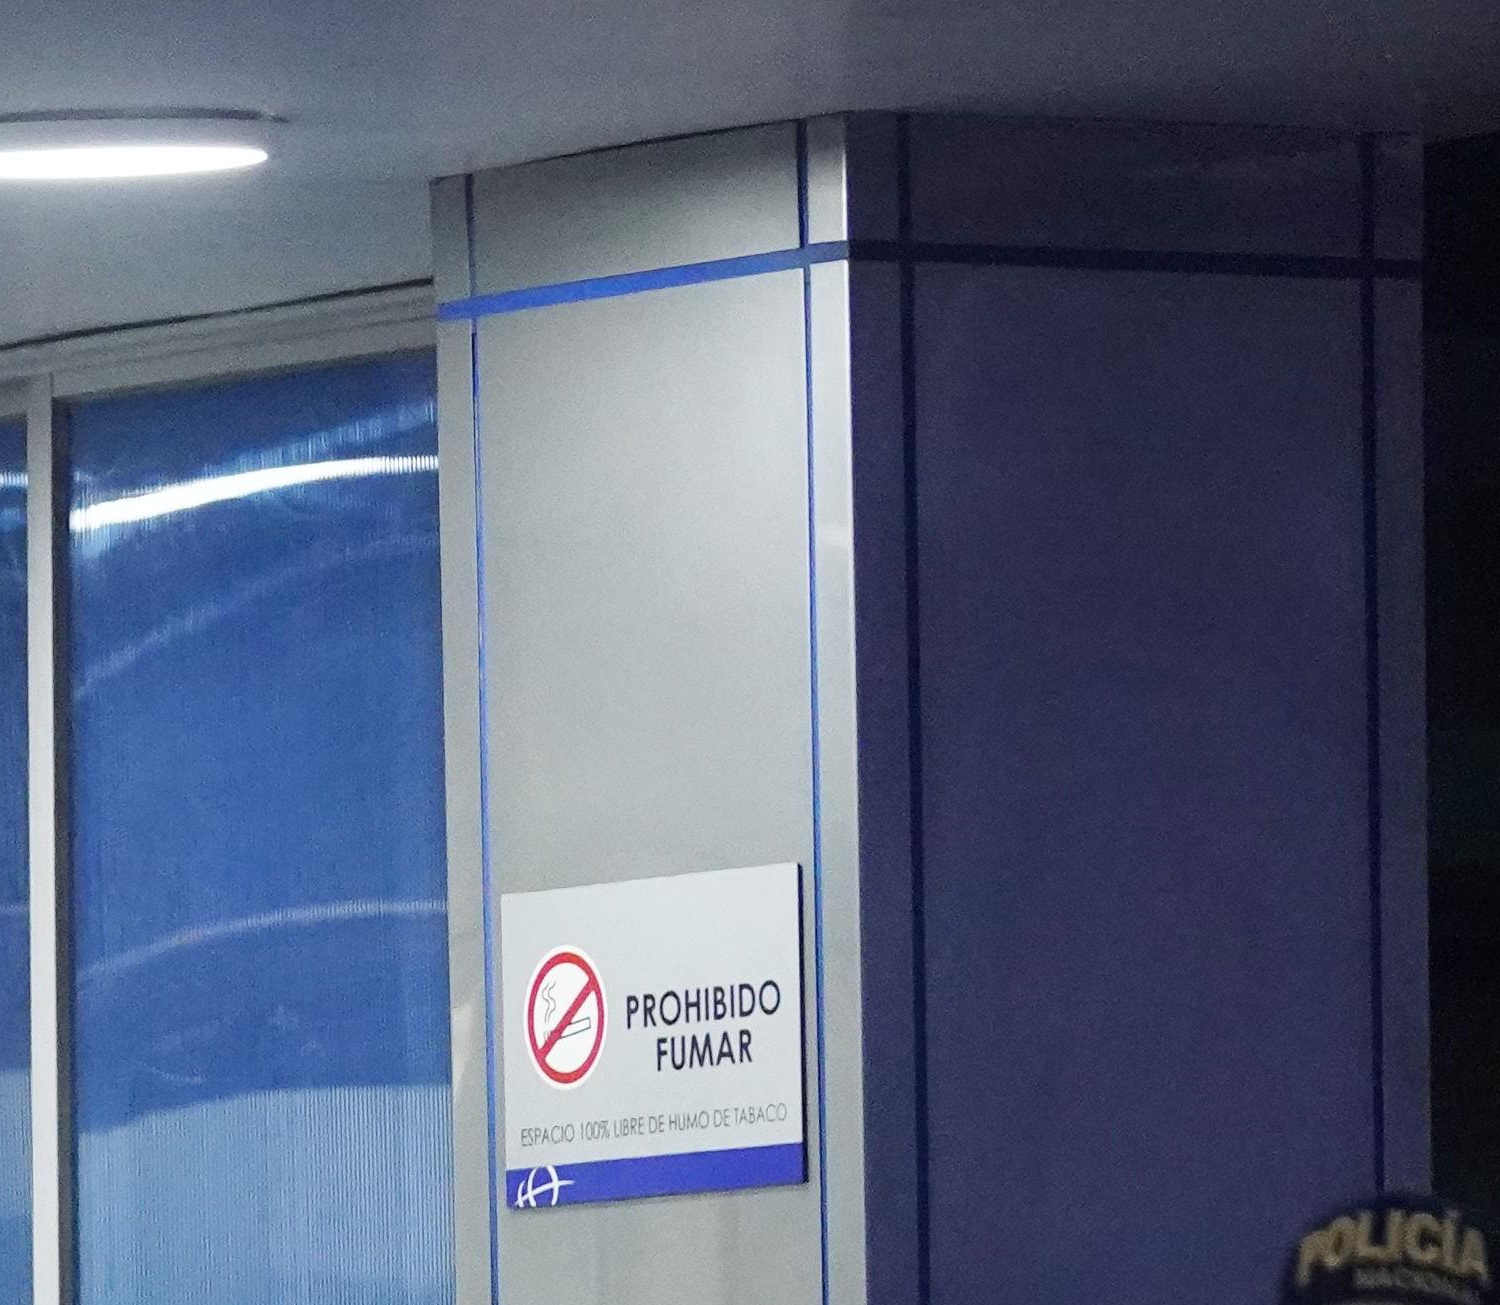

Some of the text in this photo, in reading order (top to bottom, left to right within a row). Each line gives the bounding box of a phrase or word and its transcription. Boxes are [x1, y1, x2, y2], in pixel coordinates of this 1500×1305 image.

[626, 979, 781, 1030] PROHIBIDO
[656, 1029, 753, 1073] FUMAR
[520, 1103, 788, 1147] ESPACIO 100% LIBRE DE HUMO DE TABACO
